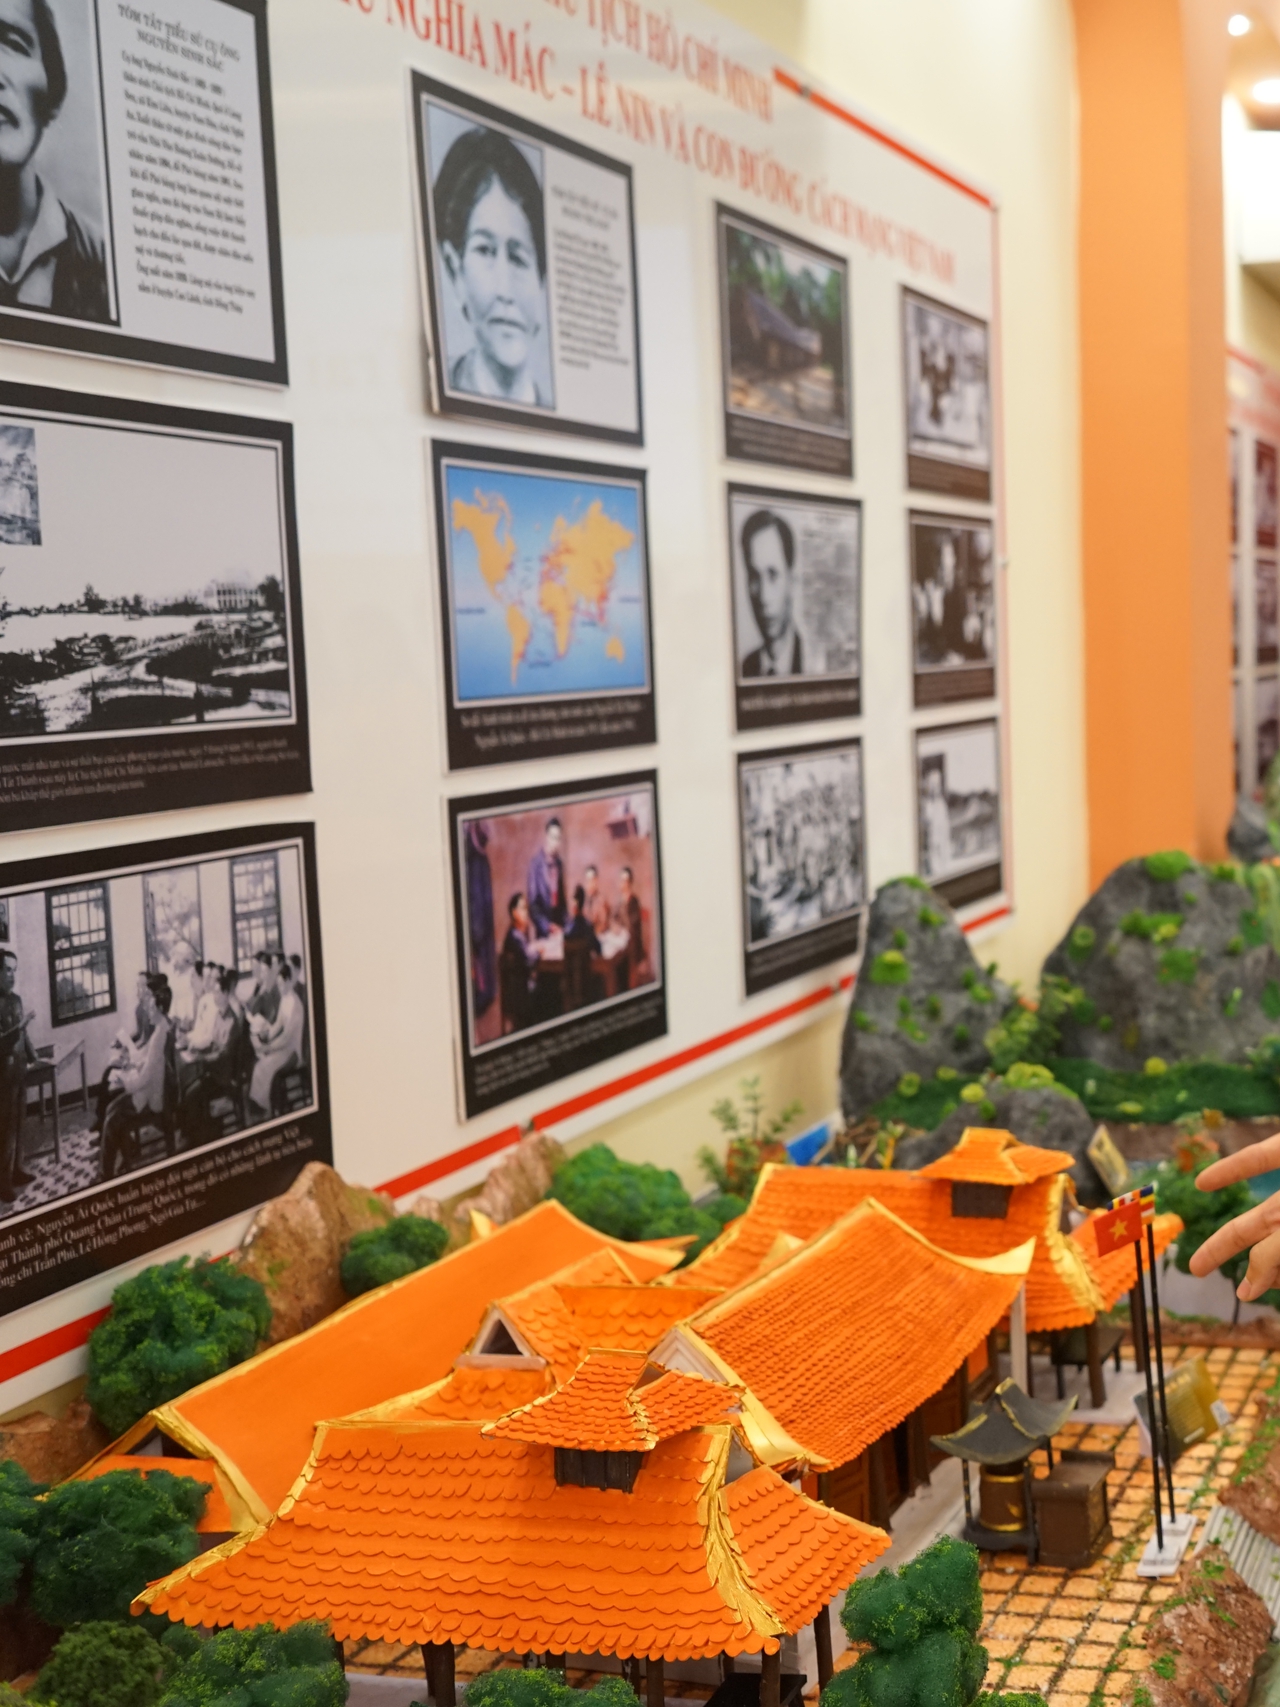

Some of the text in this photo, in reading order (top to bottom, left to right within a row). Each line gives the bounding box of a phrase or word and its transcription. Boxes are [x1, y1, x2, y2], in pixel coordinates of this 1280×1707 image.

[492, 20, 556, 101] MÁC
[579, 59, 611, 128] LÊ
[11, 1242, 42, 1265] Thành
[97, 1211, 121, 1230] Châu
[37, 1211, 75, 1237] Nguyễn
[90, 1194, 115, 1216] Quốc
[34, 1253, 56, 1274] Trần
[79, 1239, 91, 1255] Lê
[92, 1228, 118, 1250] Hồng
